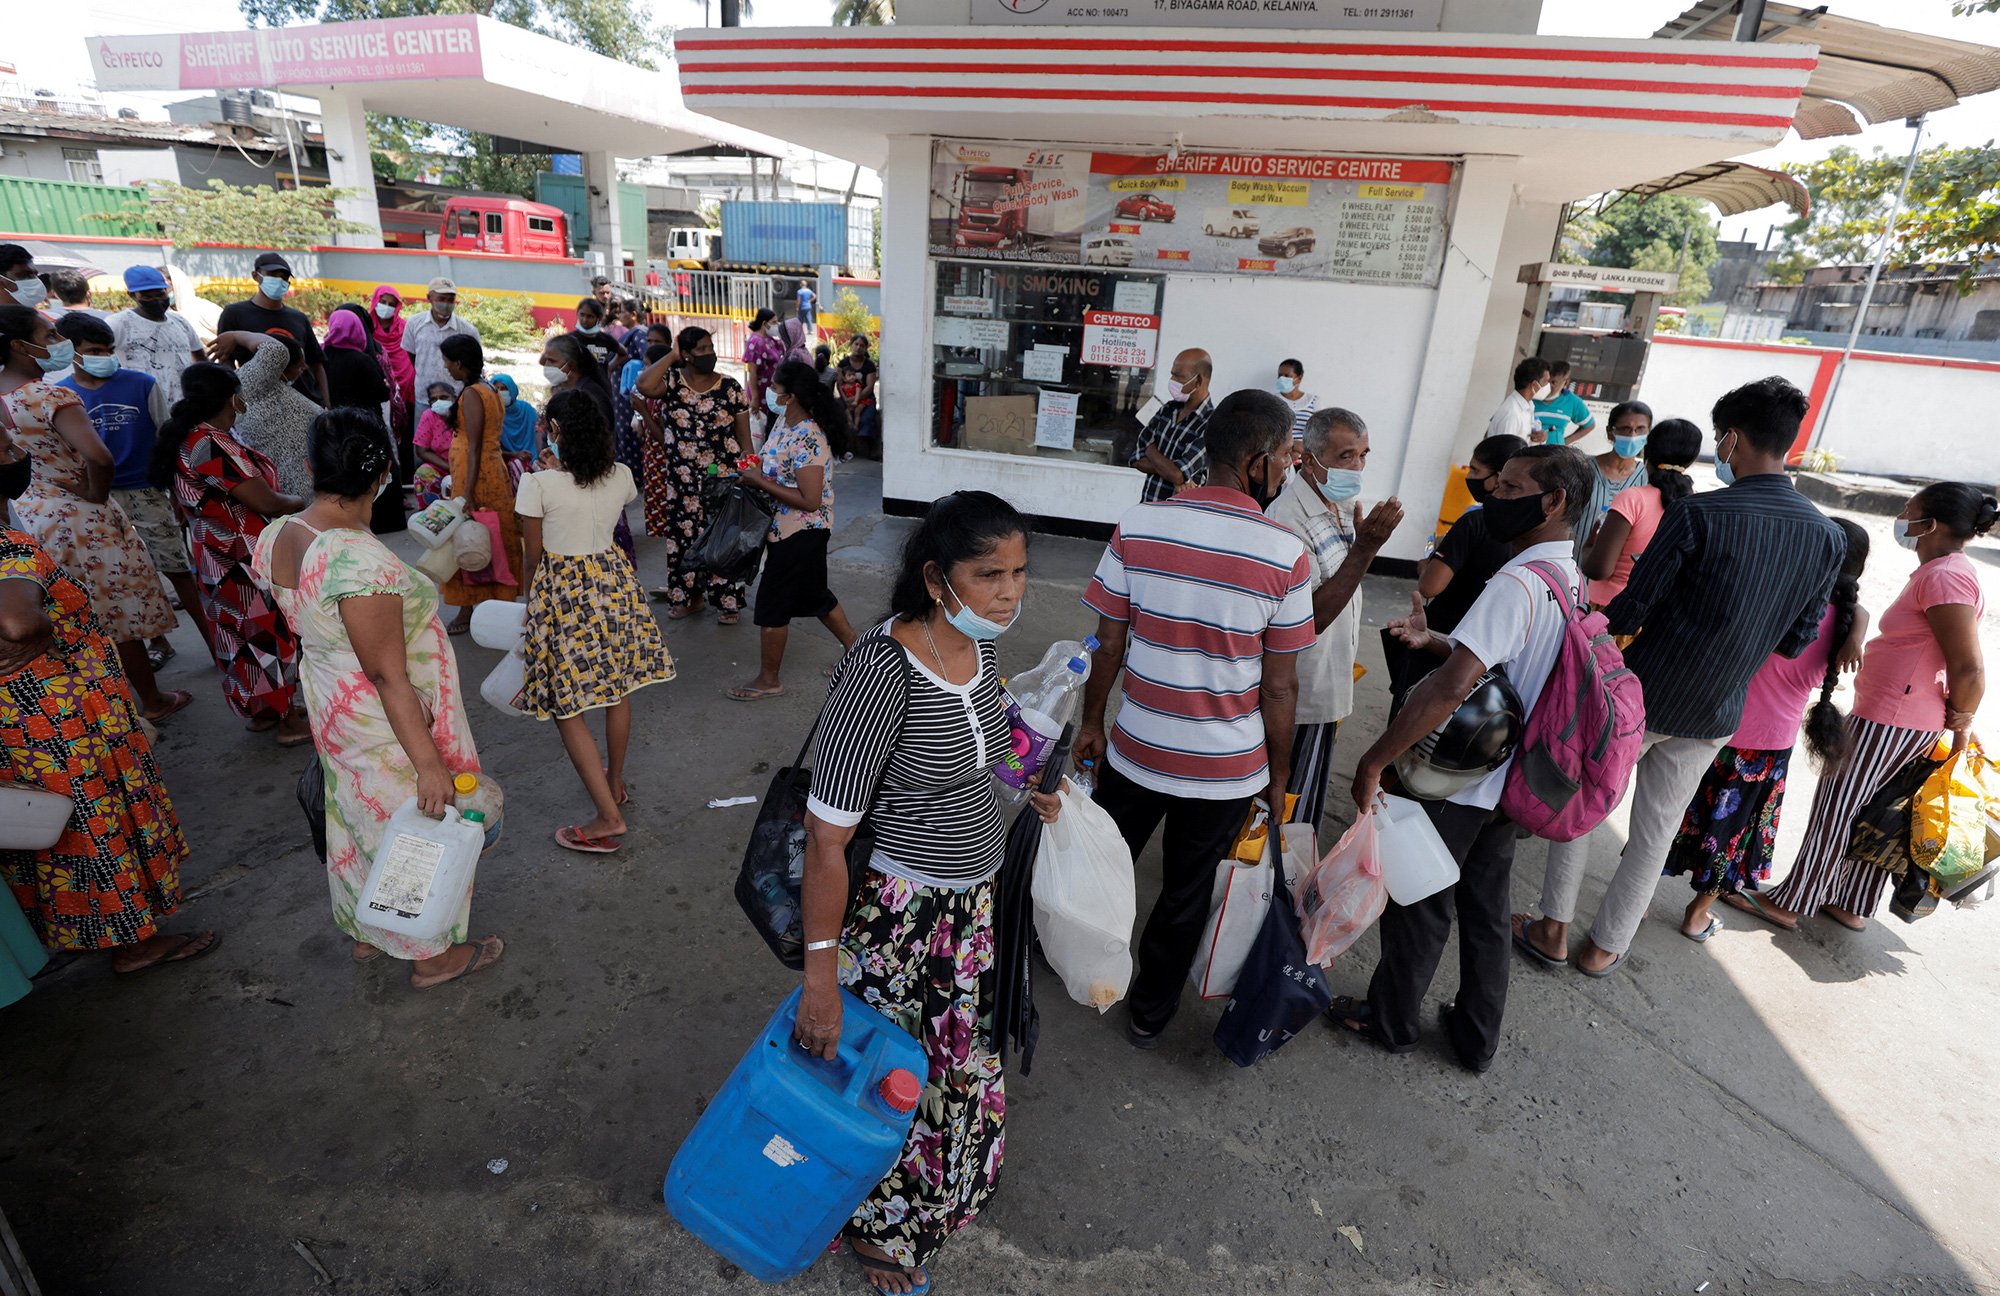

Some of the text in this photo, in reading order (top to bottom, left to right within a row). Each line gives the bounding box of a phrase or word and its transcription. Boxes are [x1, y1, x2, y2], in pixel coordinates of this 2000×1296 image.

[1169, 0, 1225, 11] BIYAGAMA
[1226, 0, 1260, 12] ROAD,
[1262, 0, 1319, 12] KELANIYA.
[1066, 8, 1129, 17] ACC NO: 100473
[1343, 7, 1414, 18] TEL: 011 2911361
[184, 27, 474, 67] SHERIFF UTO SERVICE CENTER
[101, 50, 163, 69] CEYPETCO
[357, 65, 374, 76] TEL:
[375, 64, 394, 75] 0112
[397, 62, 426, 74] 911361
[1155, 155, 1403, 179] SHERIFF AUTO SERVICE CENTRE
[1117, 178, 1179, 189] Quick Body Wash
[1231, 180, 1307, 193] Body Wash, Vaccum
[1003, 184, 1023, 196] Full
[1368, 186, 1414, 198] Full Service
[992, 187, 1079, 213] Quick Body Wash
[1251, 194, 1283, 203] and Wax
[1342, 202, 1347, 210] 6
[1348, 202, 1373, 211] WHEEL
[1375, 203, 1393, 212] FLAT
[1341, 211, 1349, 219] 10
[1350, 212, 1375, 221] WHEEL
[1377, 213, 1395, 221] FLAT
[1339, 221, 1344, 229] 6
[1345, 222, 1370, 230] WHEEL
[1371, 223, 1389, 231] FULL
[1338, 231, 1346, 239] 10
[1347, 231, 1373, 240] WHEEL
[1374, 232, 1392, 241] FULL
[1216, 239, 1231, 248] Van
[1336, 240, 1358, 248] PRIME
[1359, 241, 1390, 250] MOVERS
[1140, 250, 1154, 259] Van
[1335, 249, 1350, 258] BUS
[1346, 259, 1363, 268] BIKE
[1332, 268, 1355, 277] THREE
[1356, 269, 1391, 278] WHEELER
[994, 273, 1100, 296] NO SMOKING
[1601, 273, 1666, 286] LANKA KEROSENE
[1093, 313, 1151, 327] CEYPETCO
[1102, 338, 1137, 348] Hotlines
[1091, 345, 1147, 357] 0115 234 234
[1090, 353, 1146, 365] 0115 455 130
